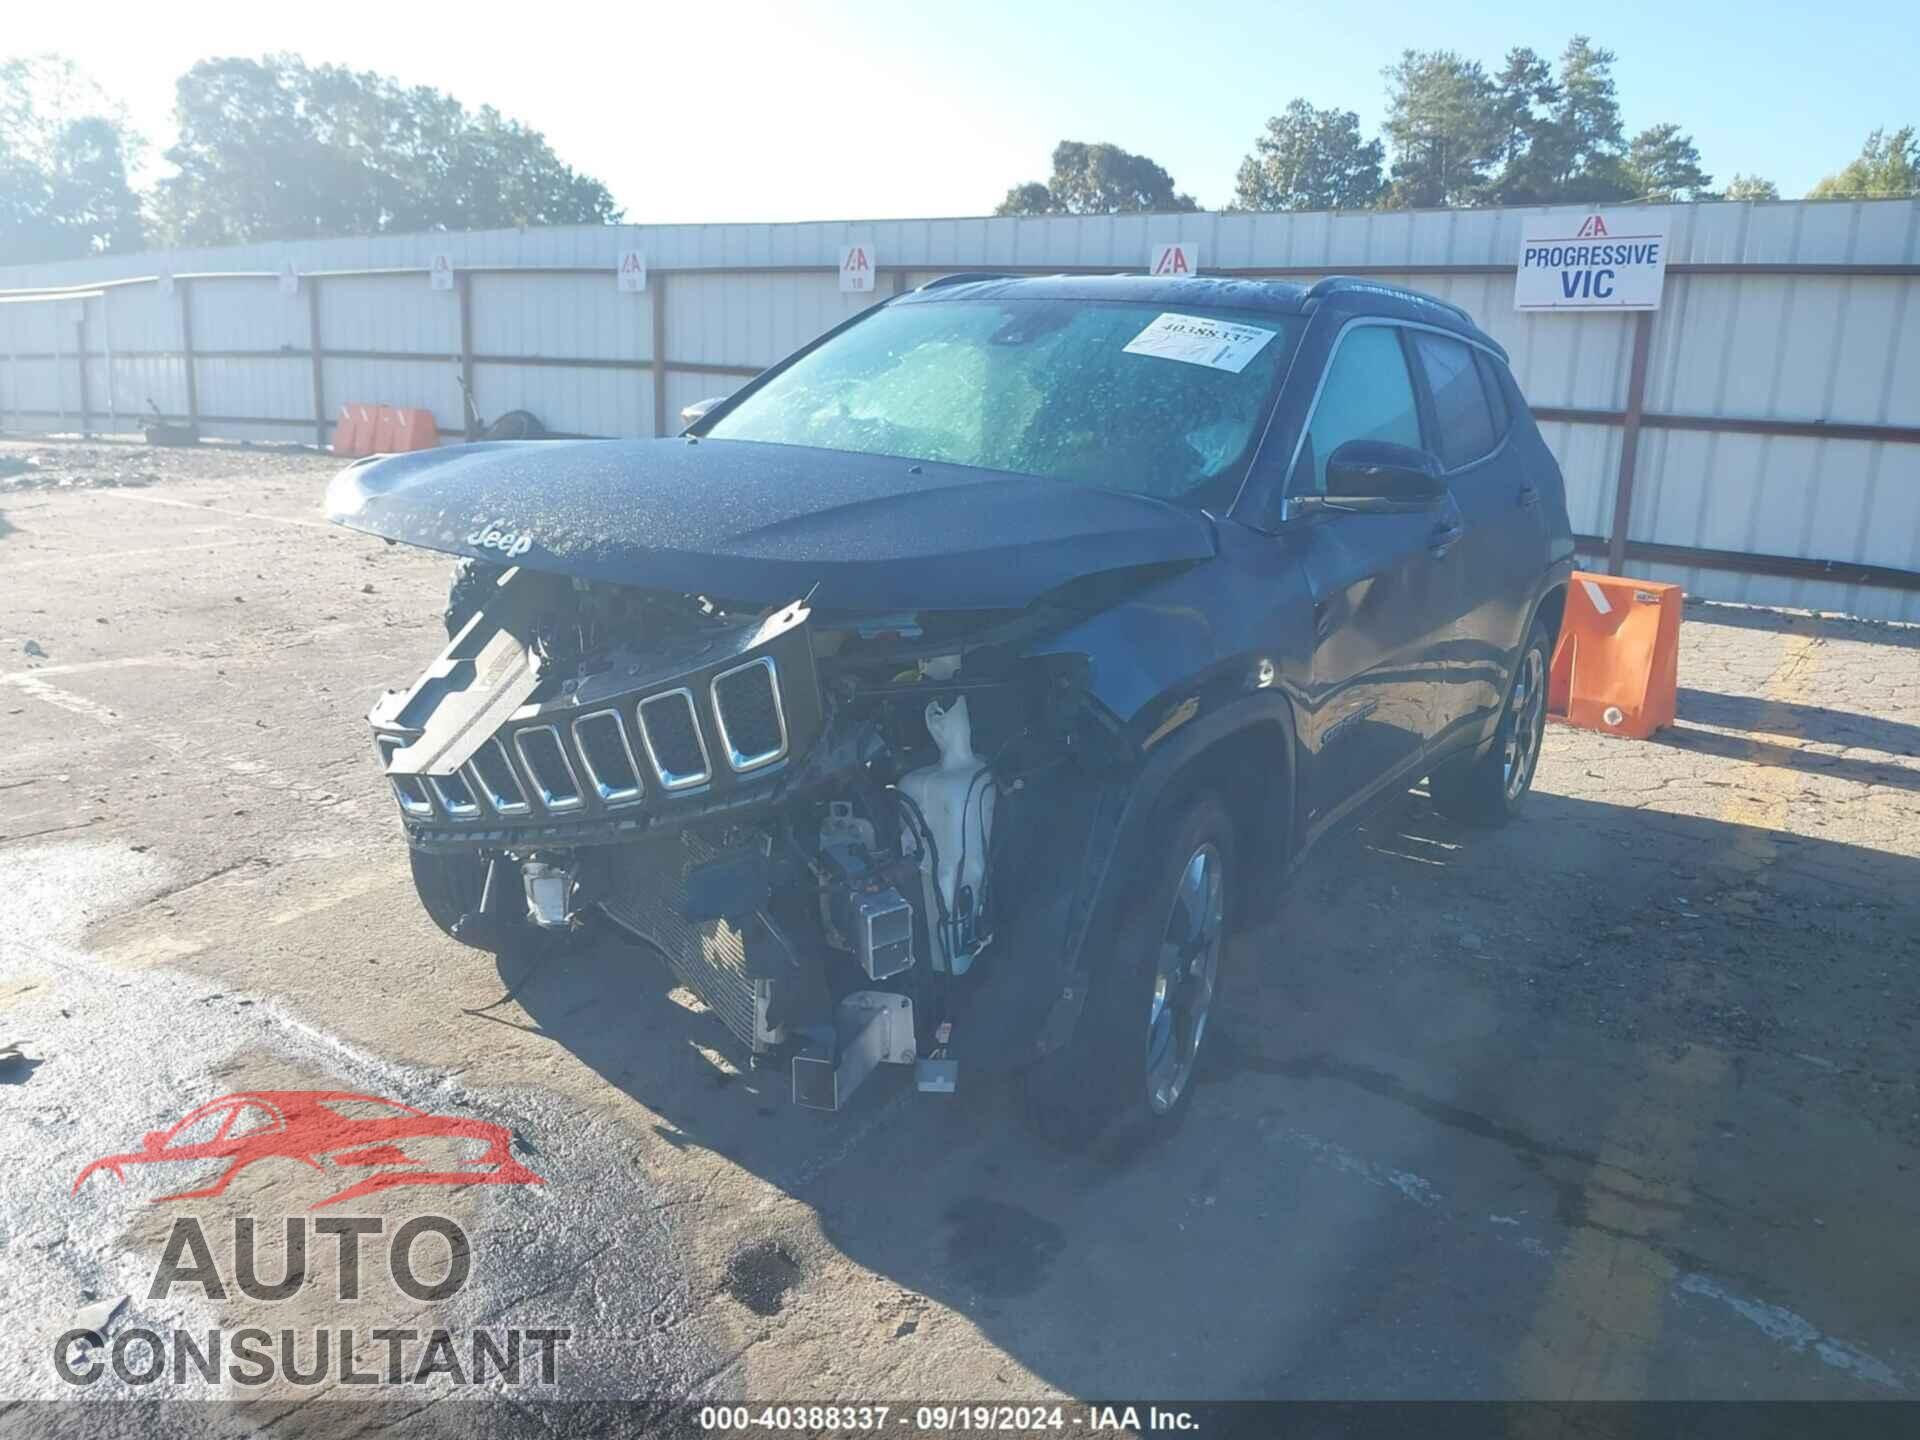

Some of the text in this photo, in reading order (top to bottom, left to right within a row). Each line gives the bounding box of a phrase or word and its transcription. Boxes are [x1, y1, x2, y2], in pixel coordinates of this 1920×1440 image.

[1524, 244, 1660, 268] PROGRESSIVE
[1561, 269, 1615, 299] VIC
[467, 520, 532, 557] Jeep
